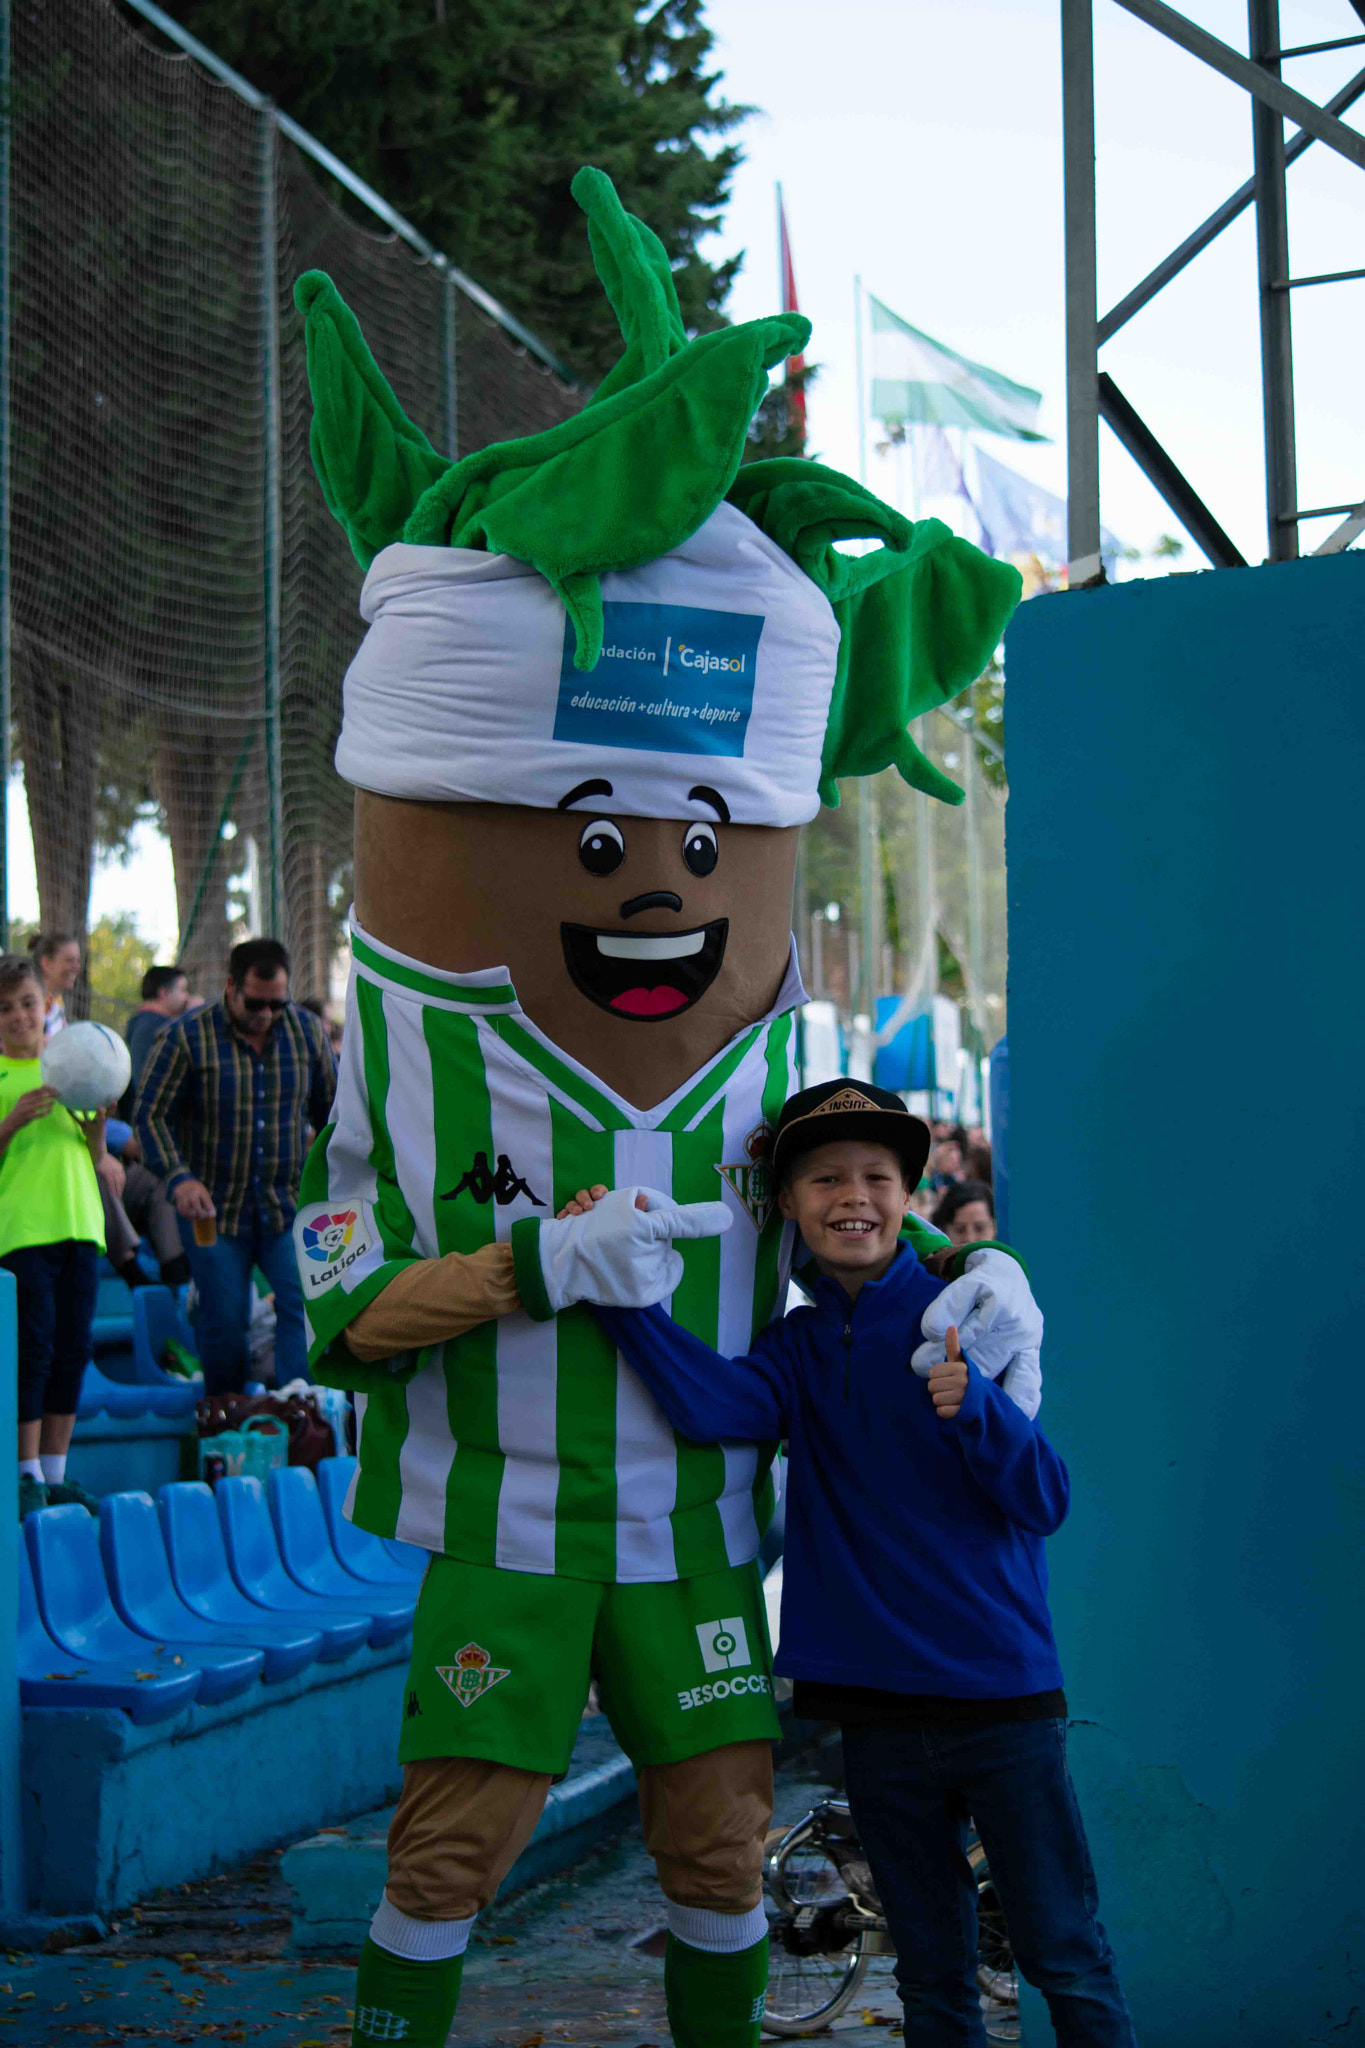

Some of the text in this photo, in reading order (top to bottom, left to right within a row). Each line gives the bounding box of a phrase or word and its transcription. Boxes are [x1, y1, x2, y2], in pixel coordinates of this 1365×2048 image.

[601, 644, 745, 675] ndación Cajasol
[310, 1243, 367, 1287] LaLiga
